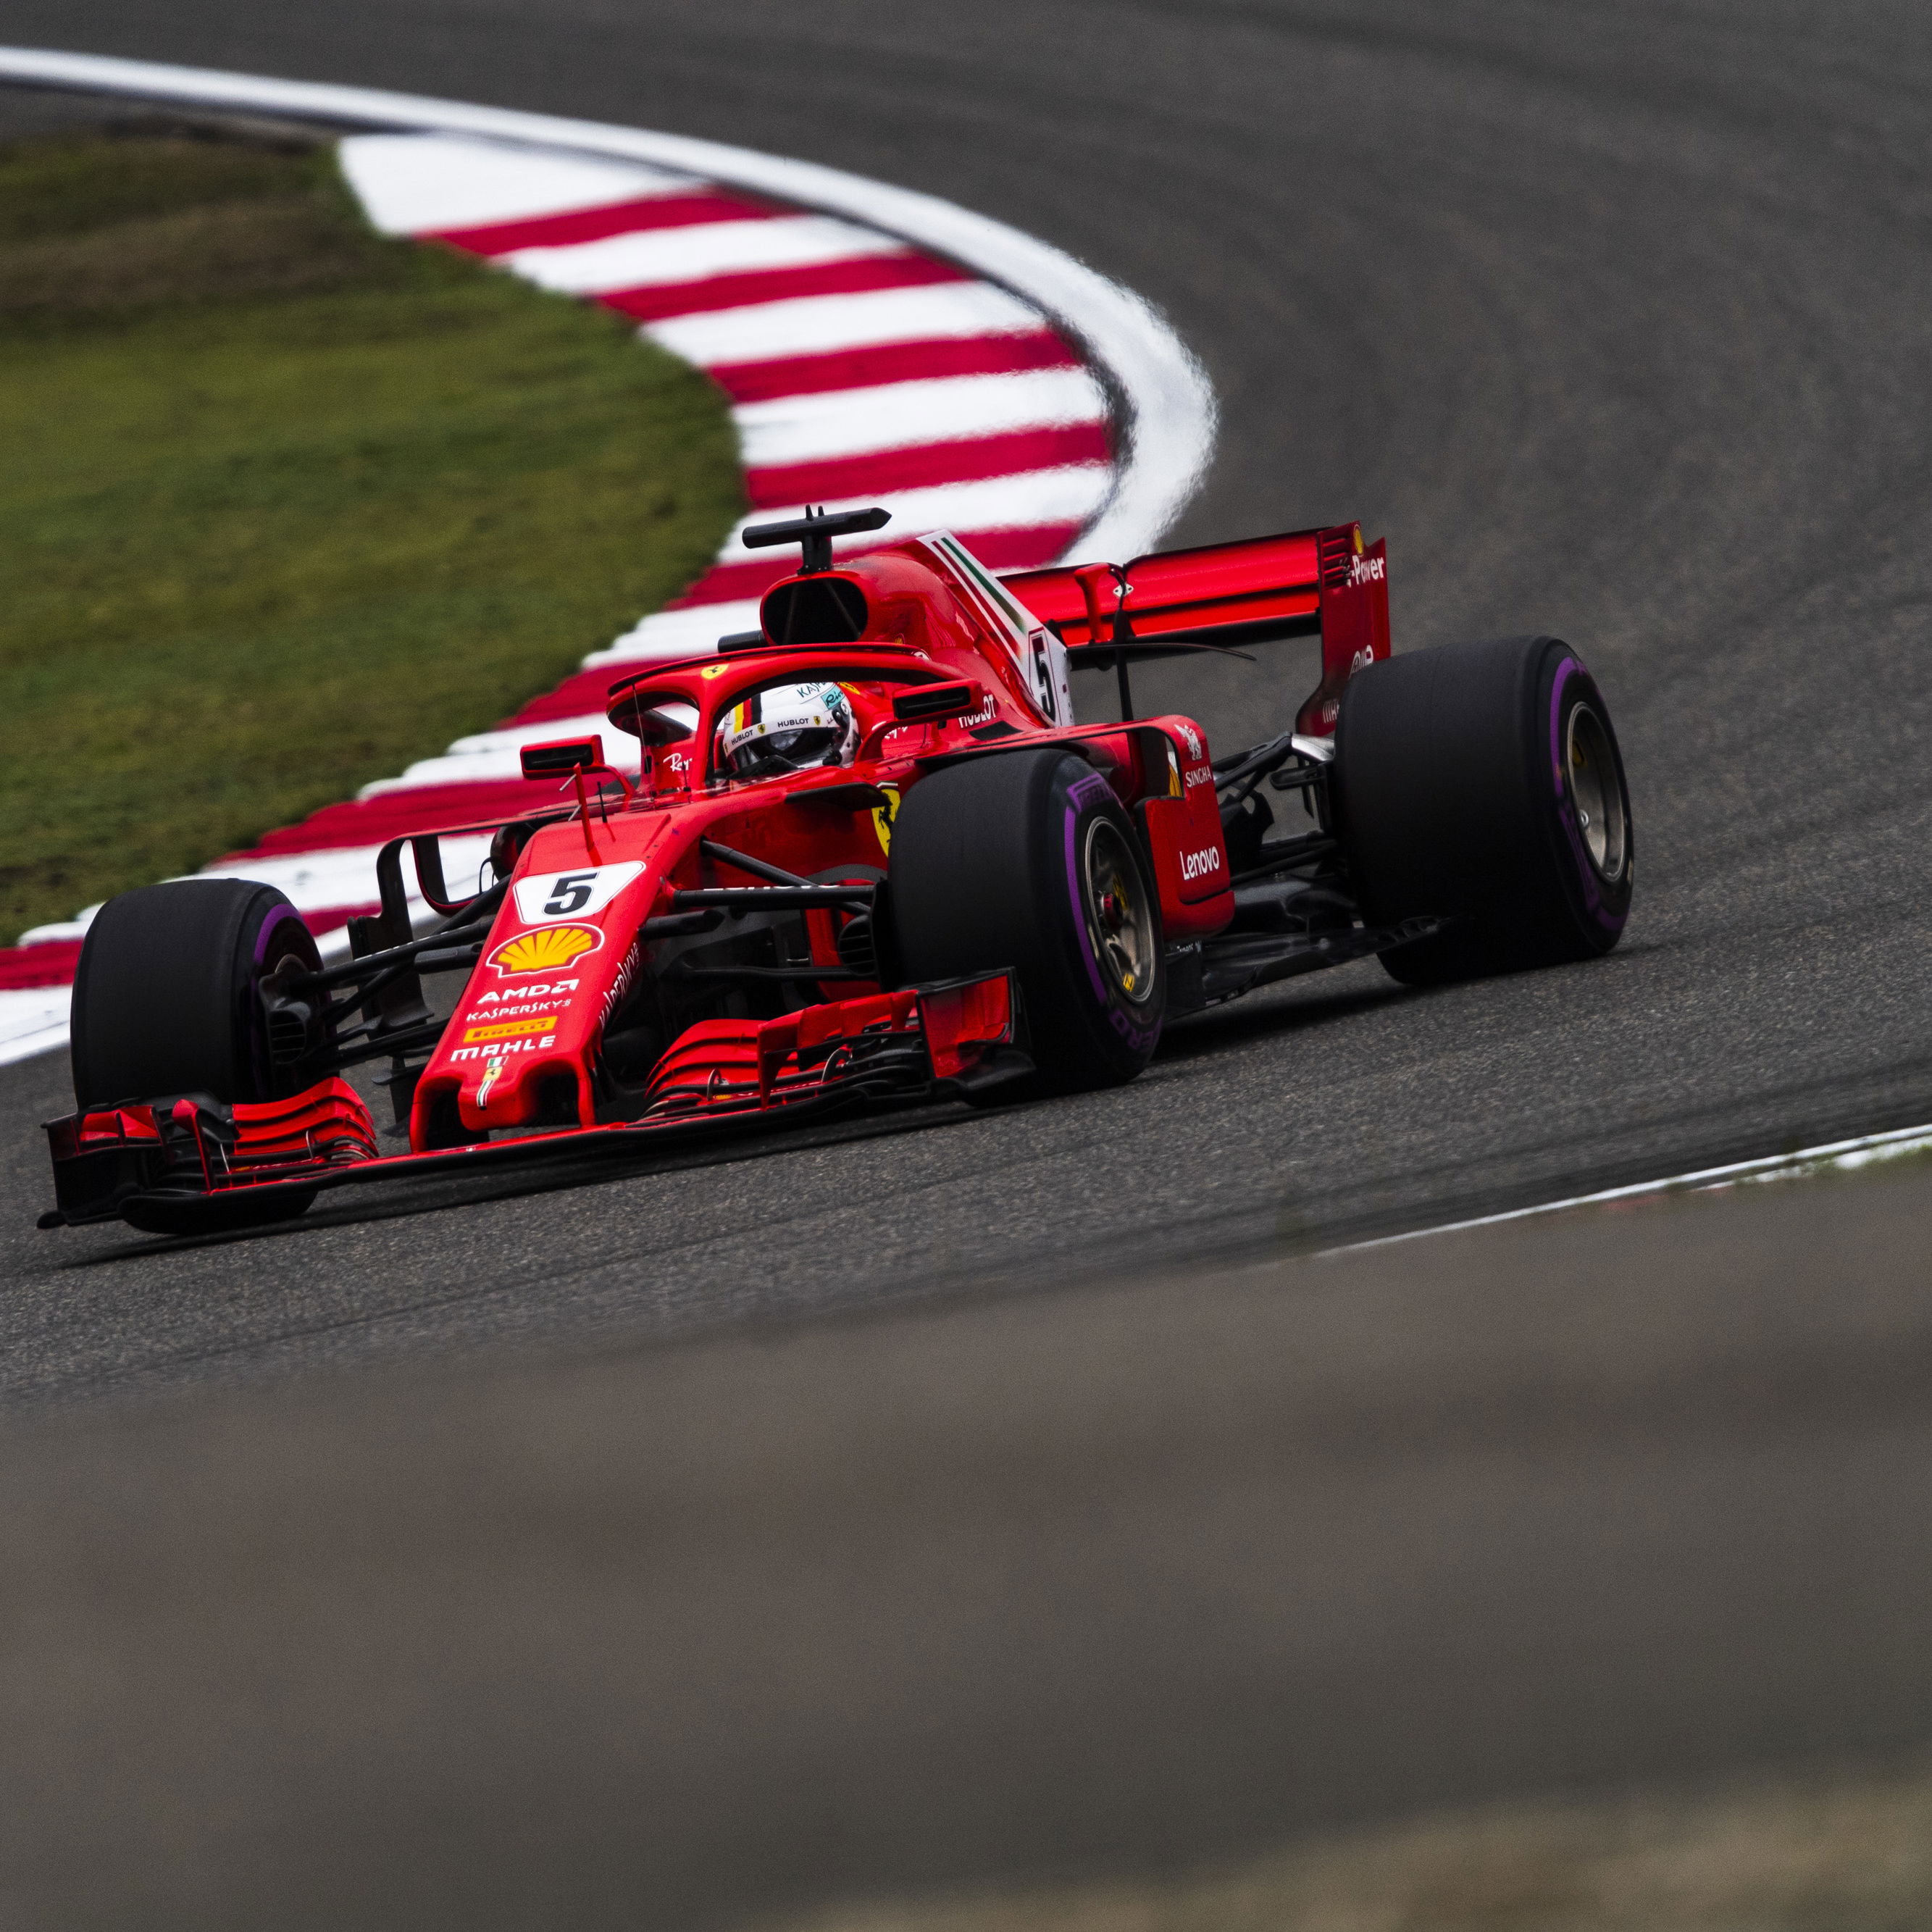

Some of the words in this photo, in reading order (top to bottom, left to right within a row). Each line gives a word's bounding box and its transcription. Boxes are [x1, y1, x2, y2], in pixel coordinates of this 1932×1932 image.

[1031, 635, 1056, 722] 5
[777, 718, 809, 728] HUBLOT
[731, 729, 753, 745] HUBLOT
[1185, 765, 1212, 788] SINGHA
[1179, 845, 1220, 881] Lenovo
[543, 871, 601, 915] 5
[477, 984, 551, 1005] AMD
[466, 999, 564, 1022] KASPERSKY
[450, 1034, 556, 1062] MAHLE
